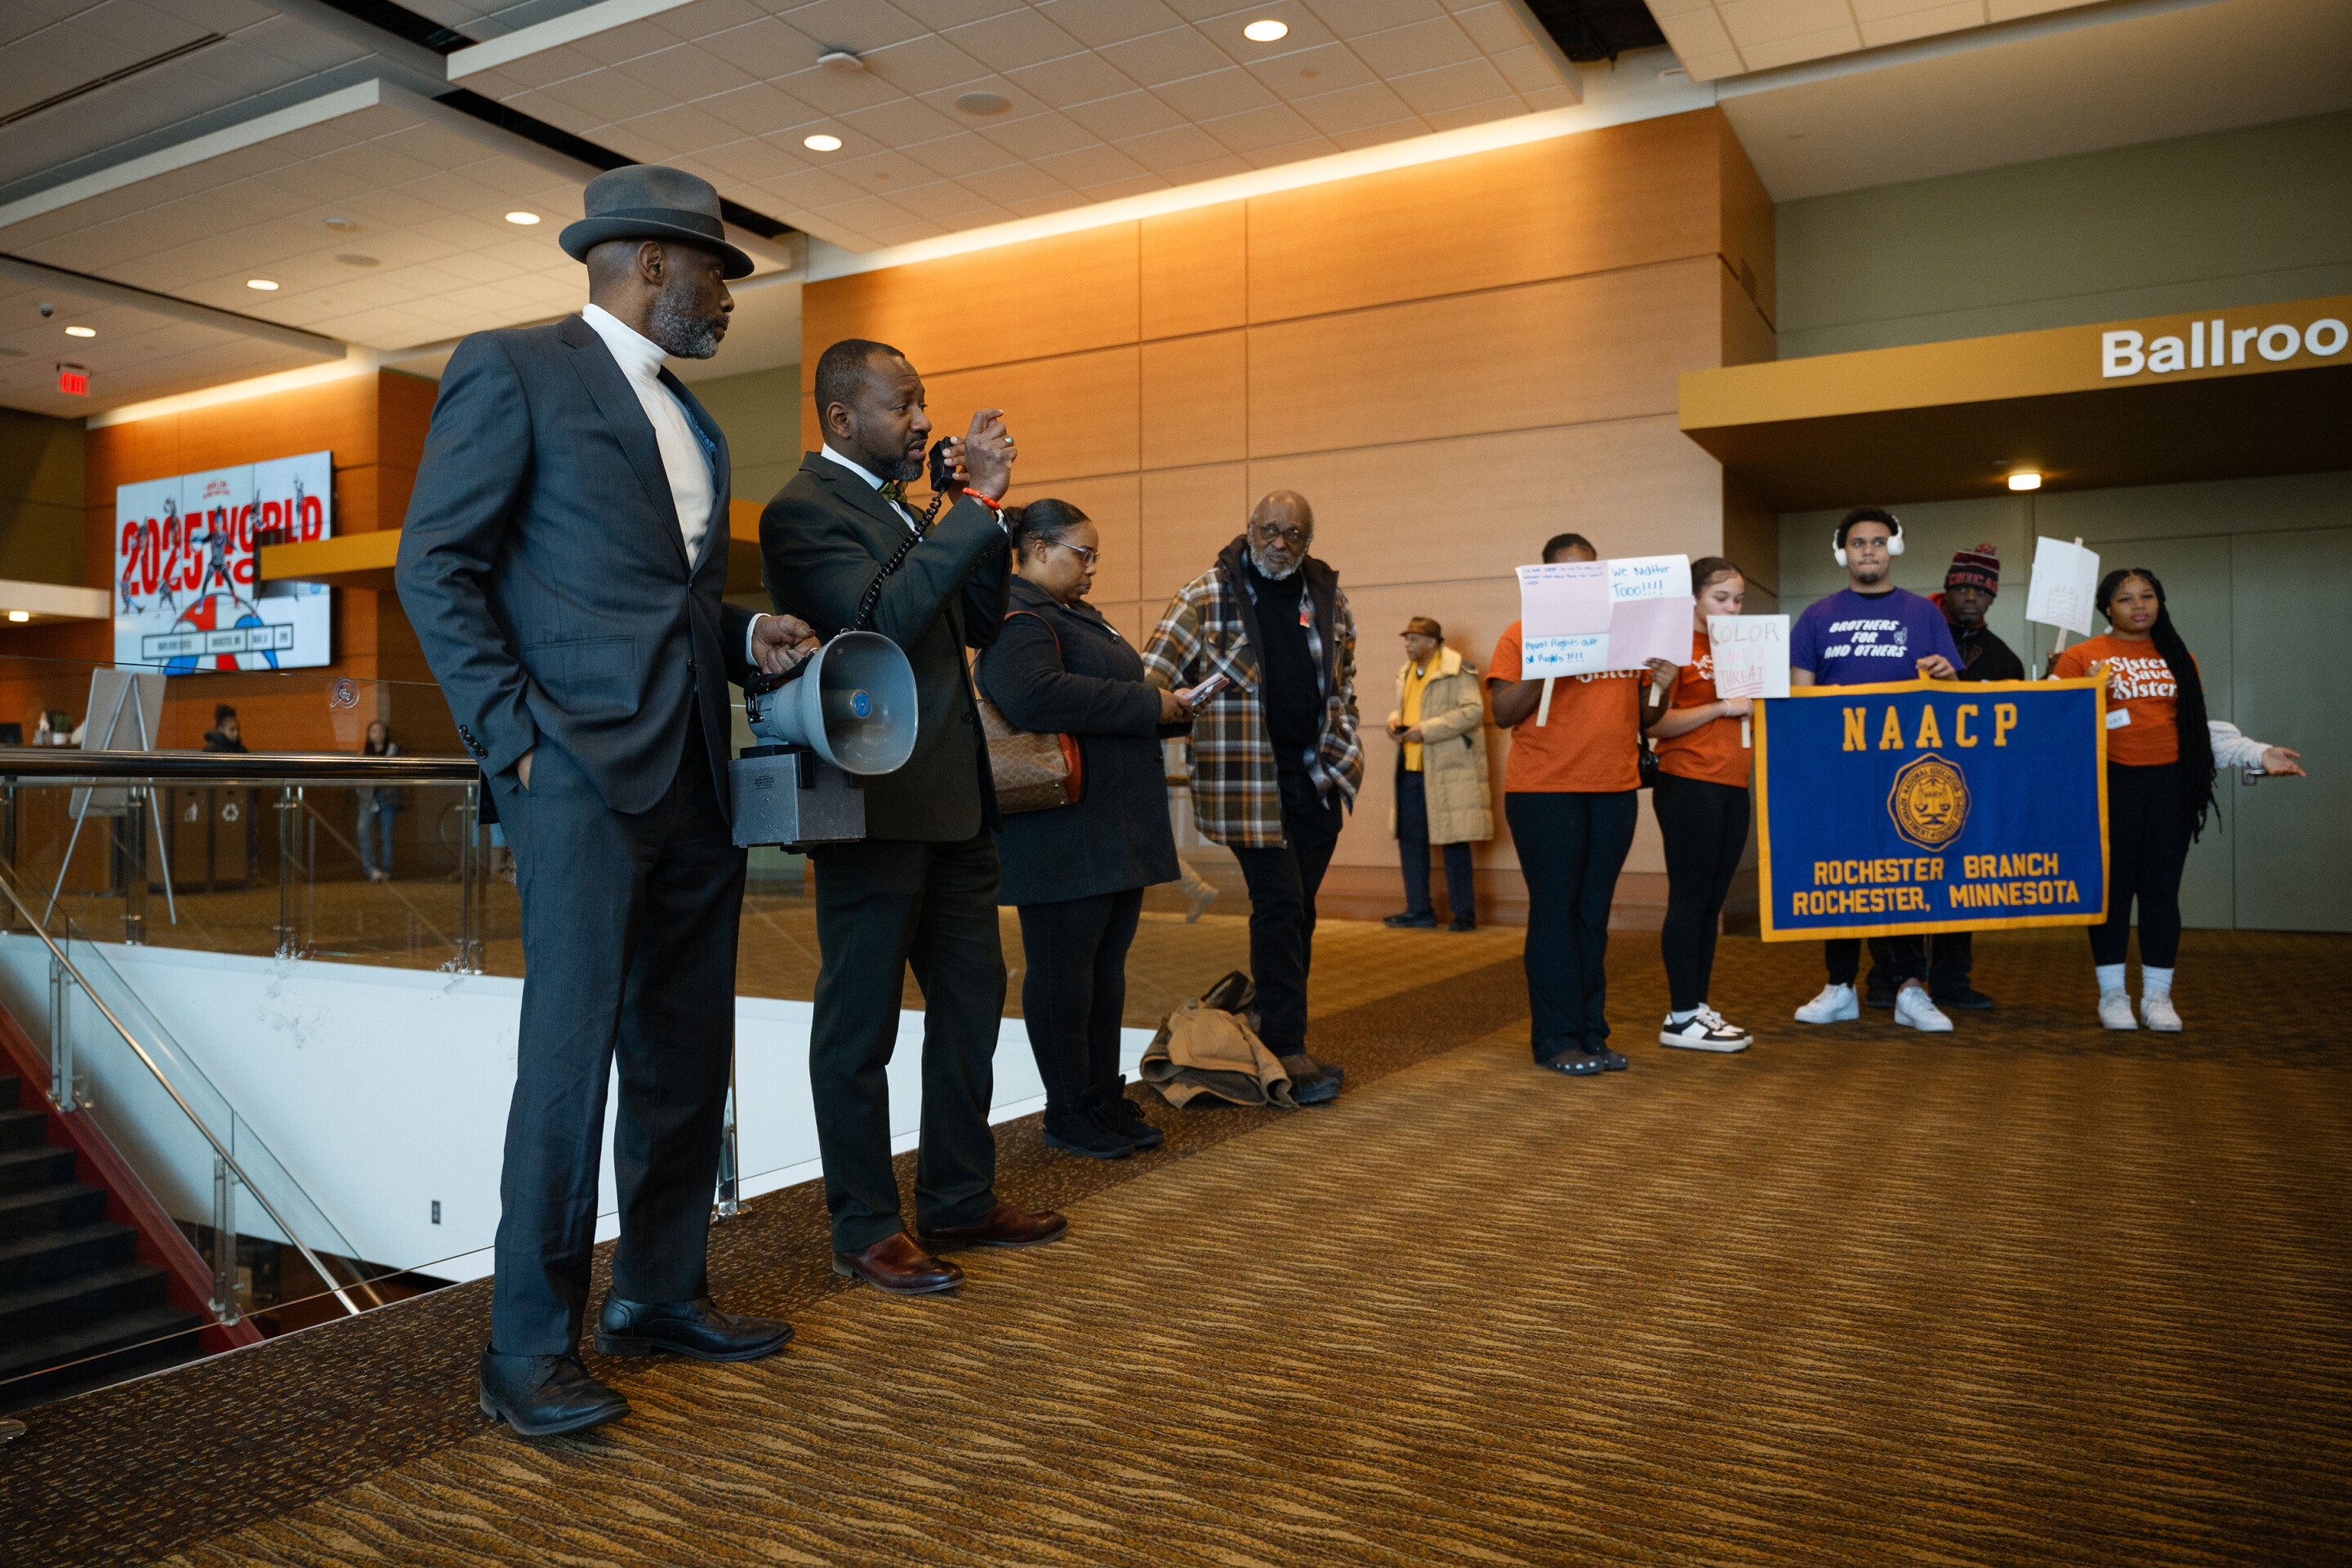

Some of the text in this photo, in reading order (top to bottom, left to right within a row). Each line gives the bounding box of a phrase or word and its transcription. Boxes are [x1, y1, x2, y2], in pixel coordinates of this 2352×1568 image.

[2102, 318, 2349, 378] Ballroo
[121, 495, 323, 597] 2025 WORLD
[1710, 621, 1780, 647] COLOR
[1829, 619, 1900, 633] BROTHERS
[1851, 631, 1878, 644] FOR
[1824, 644, 1908, 660] AND OTHERS
[1719, 665, 1764, 686] THREAT
[1842, 703, 2018, 751] NAACP
[1814, 853, 2059, 885] ROCHESTER BRANCH
[1793, 880, 2080, 916] ROCHESTER, MINNESOTA
